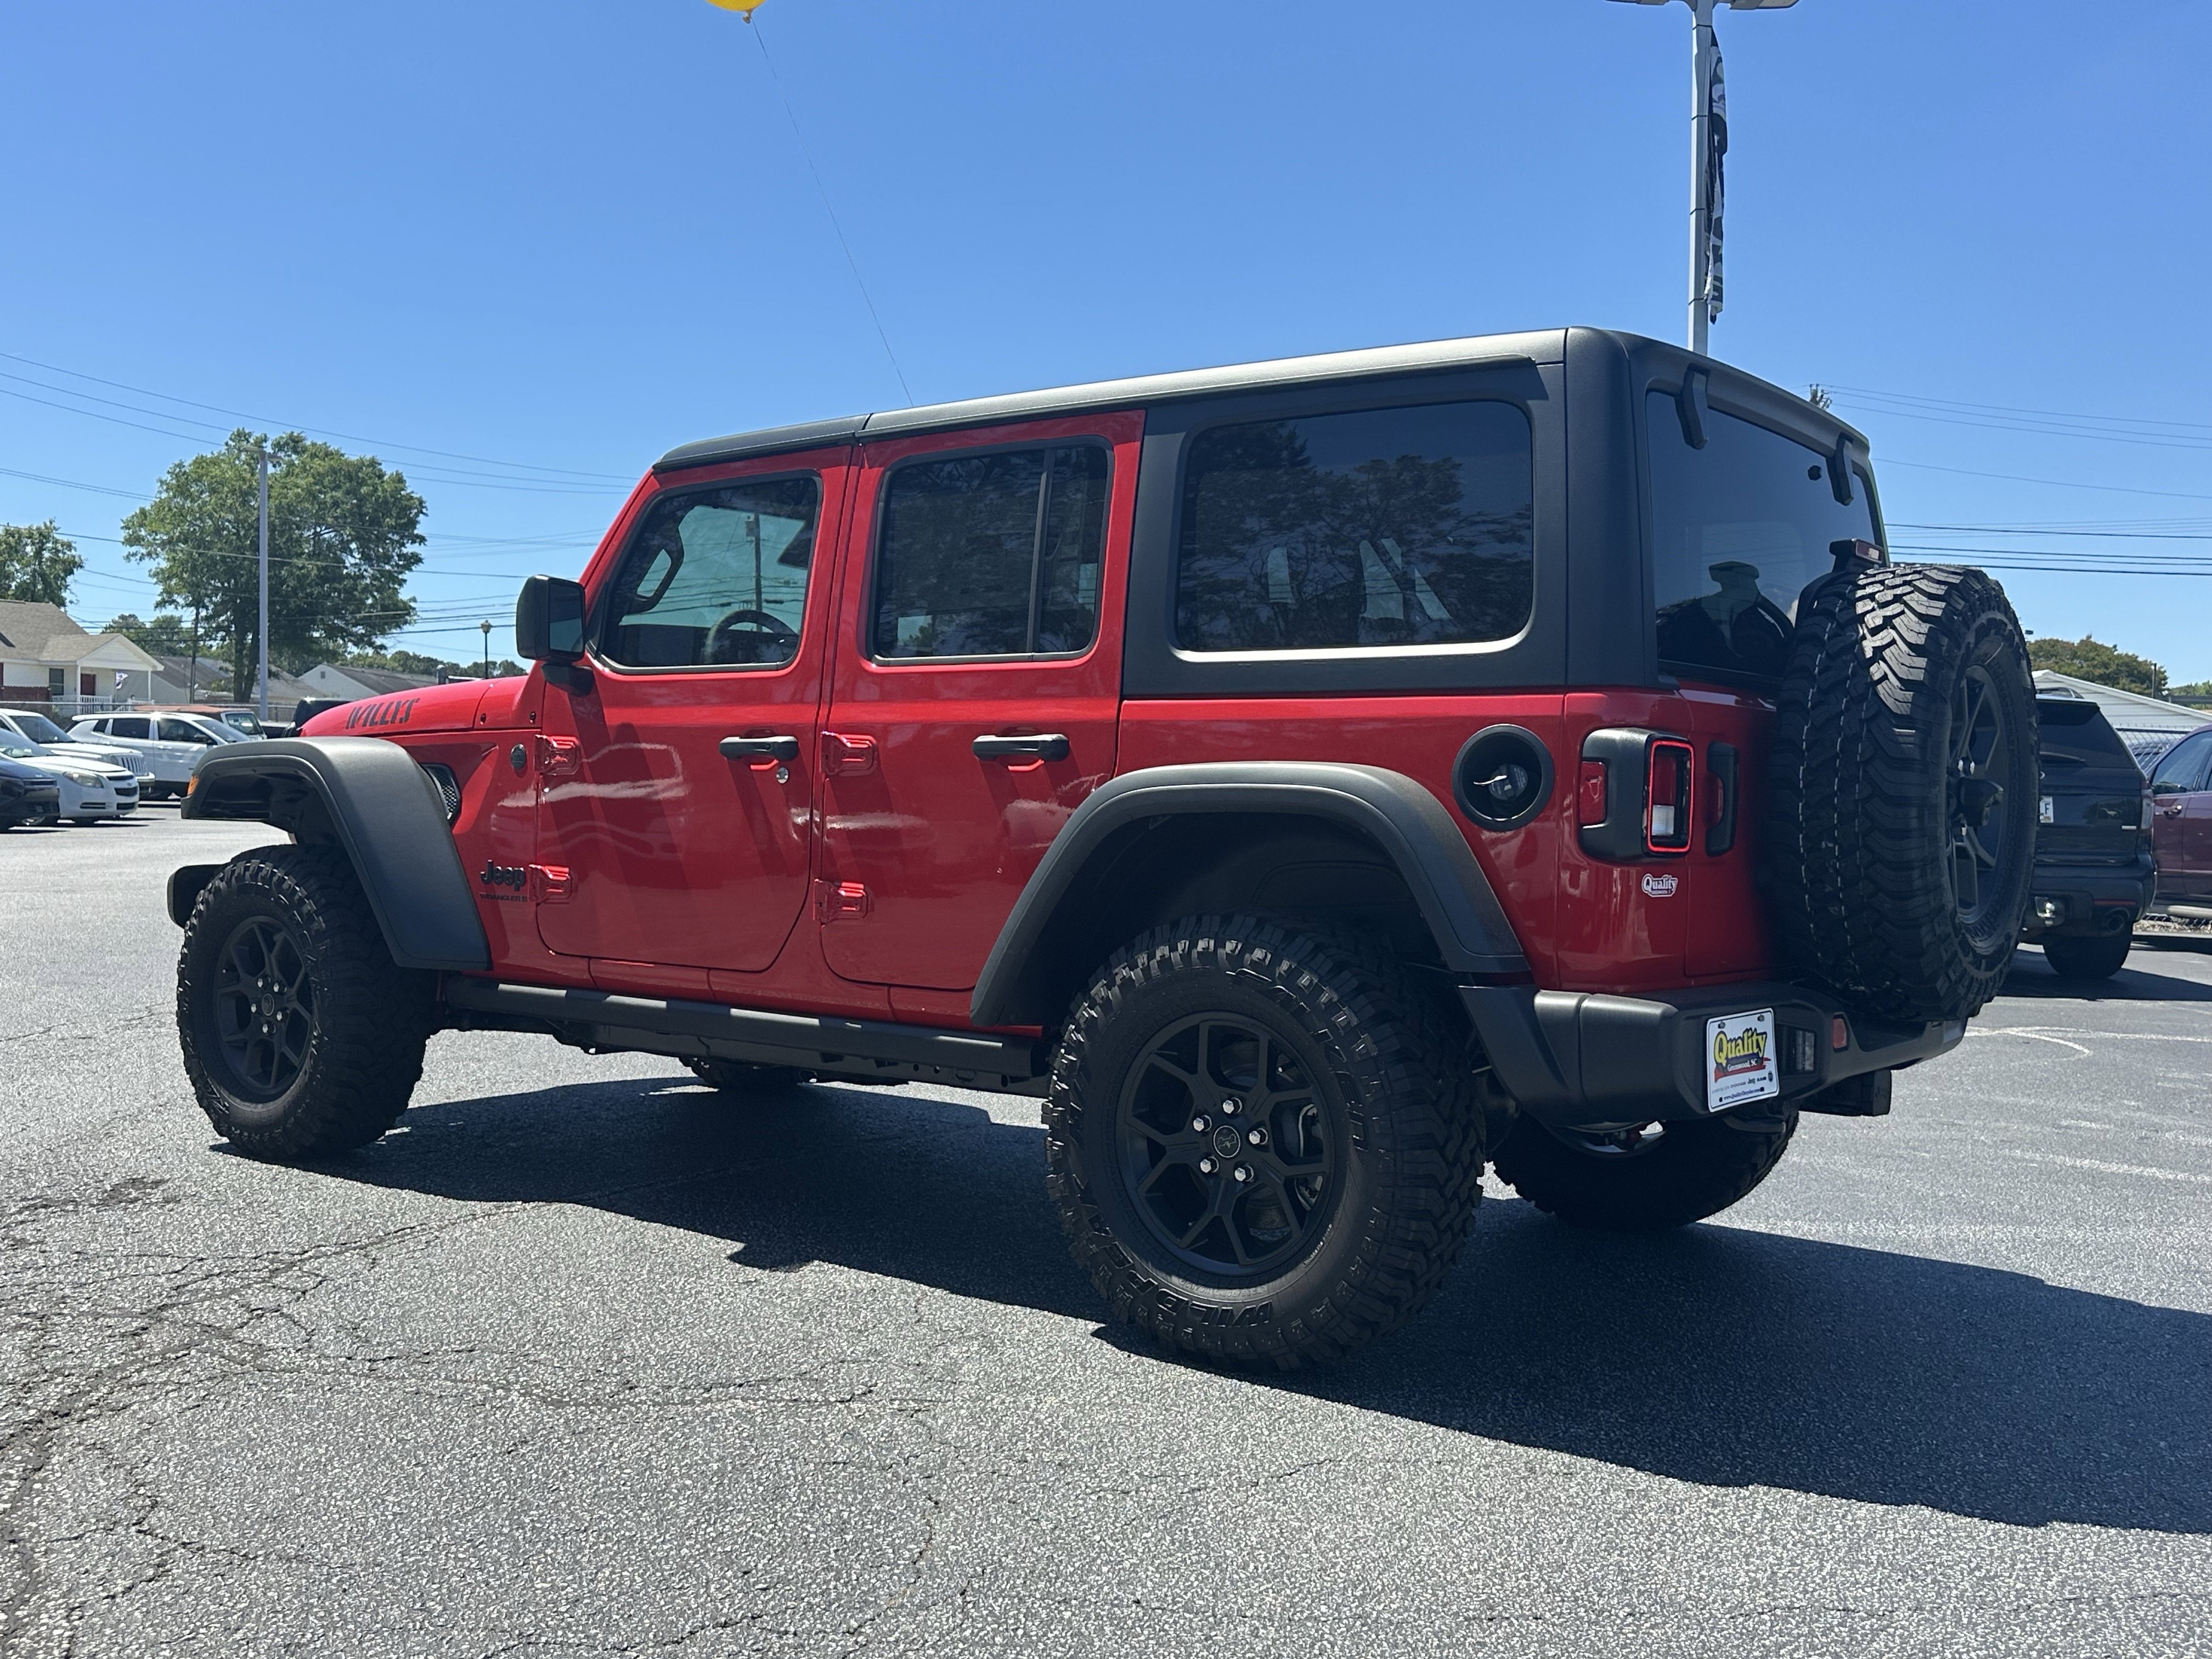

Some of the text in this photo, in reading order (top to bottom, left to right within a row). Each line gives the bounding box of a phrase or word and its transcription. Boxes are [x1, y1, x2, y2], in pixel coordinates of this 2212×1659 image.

[346, 698, 420, 729] WILLYS
[481, 859, 526, 891] Jeep
[1643, 876, 1677, 893] Quality
[1714, 1029, 1766, 1066] Quality
